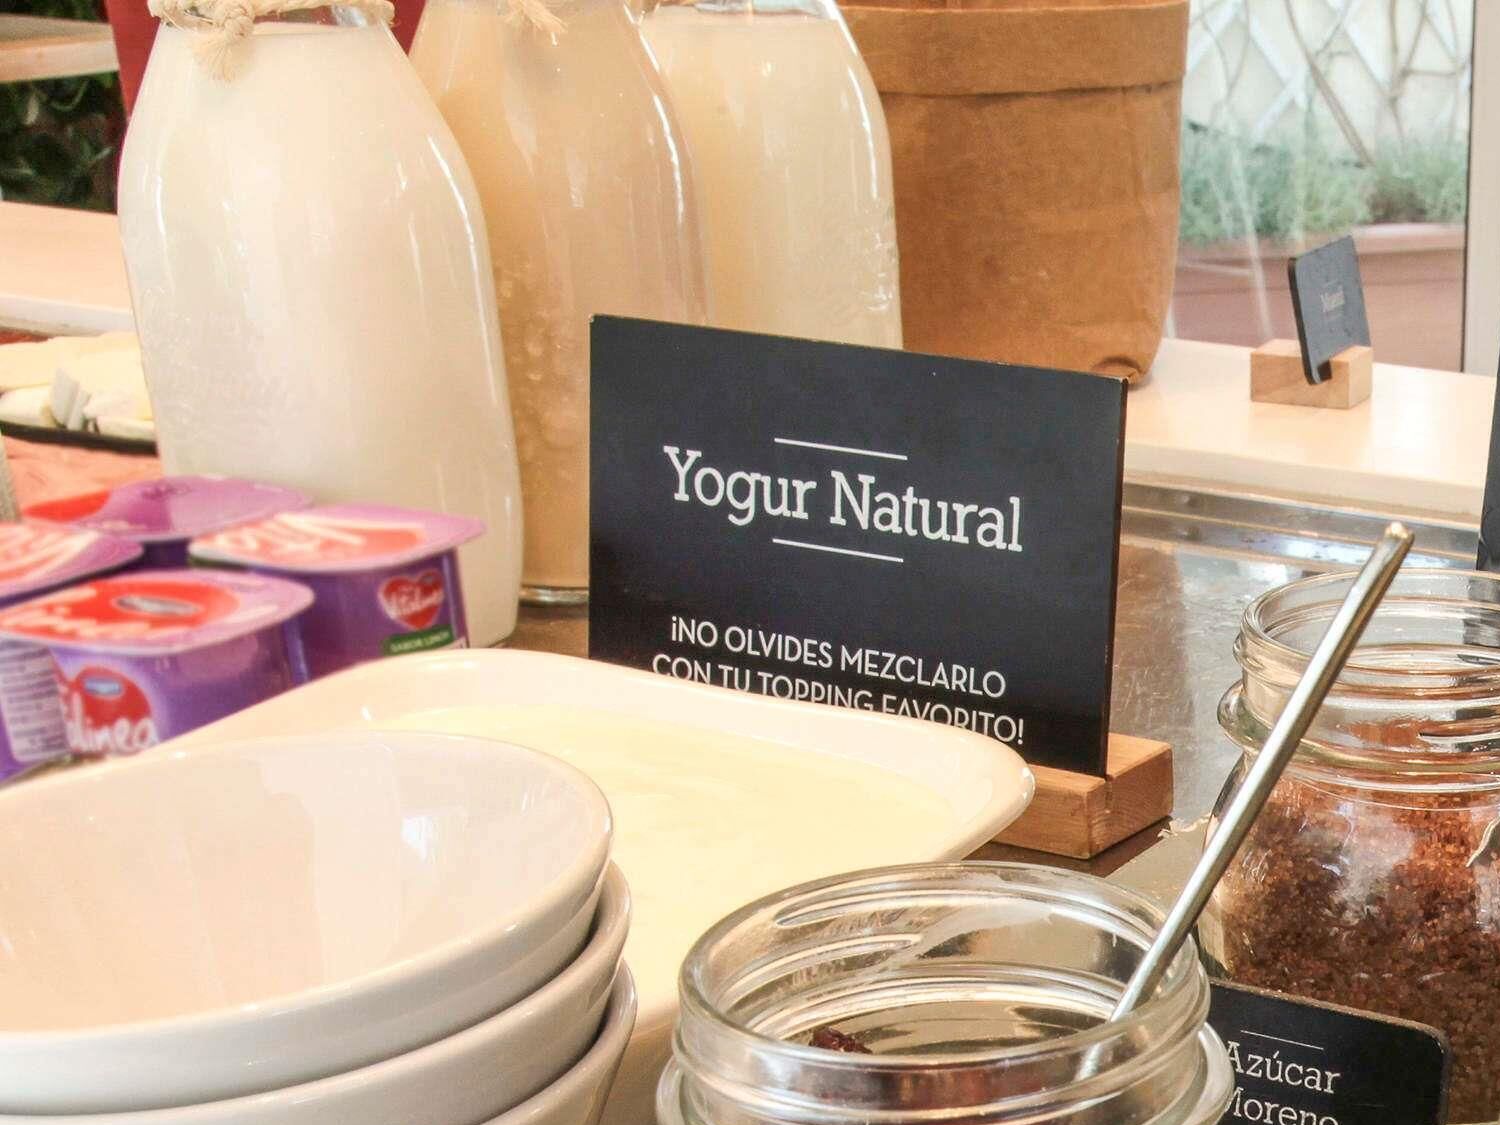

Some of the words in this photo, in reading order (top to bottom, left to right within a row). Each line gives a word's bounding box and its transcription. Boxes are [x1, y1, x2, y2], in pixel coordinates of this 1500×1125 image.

[663, 445, 816, 526] Yogur
[829, 470, 1023, 552] Natural
[652, 653, 711, 685] CON
[718, 664, 750, 693] TU
[758, 671, 873, 713] TOPPING
[881, 693, 1024, 745] FAVORITO!
[724, 625, 833, 669] OLVIDES
[840, 644, 1006, 698] MEZCLARLO
[1226, 1040, 1341, 1094] Azúcar
